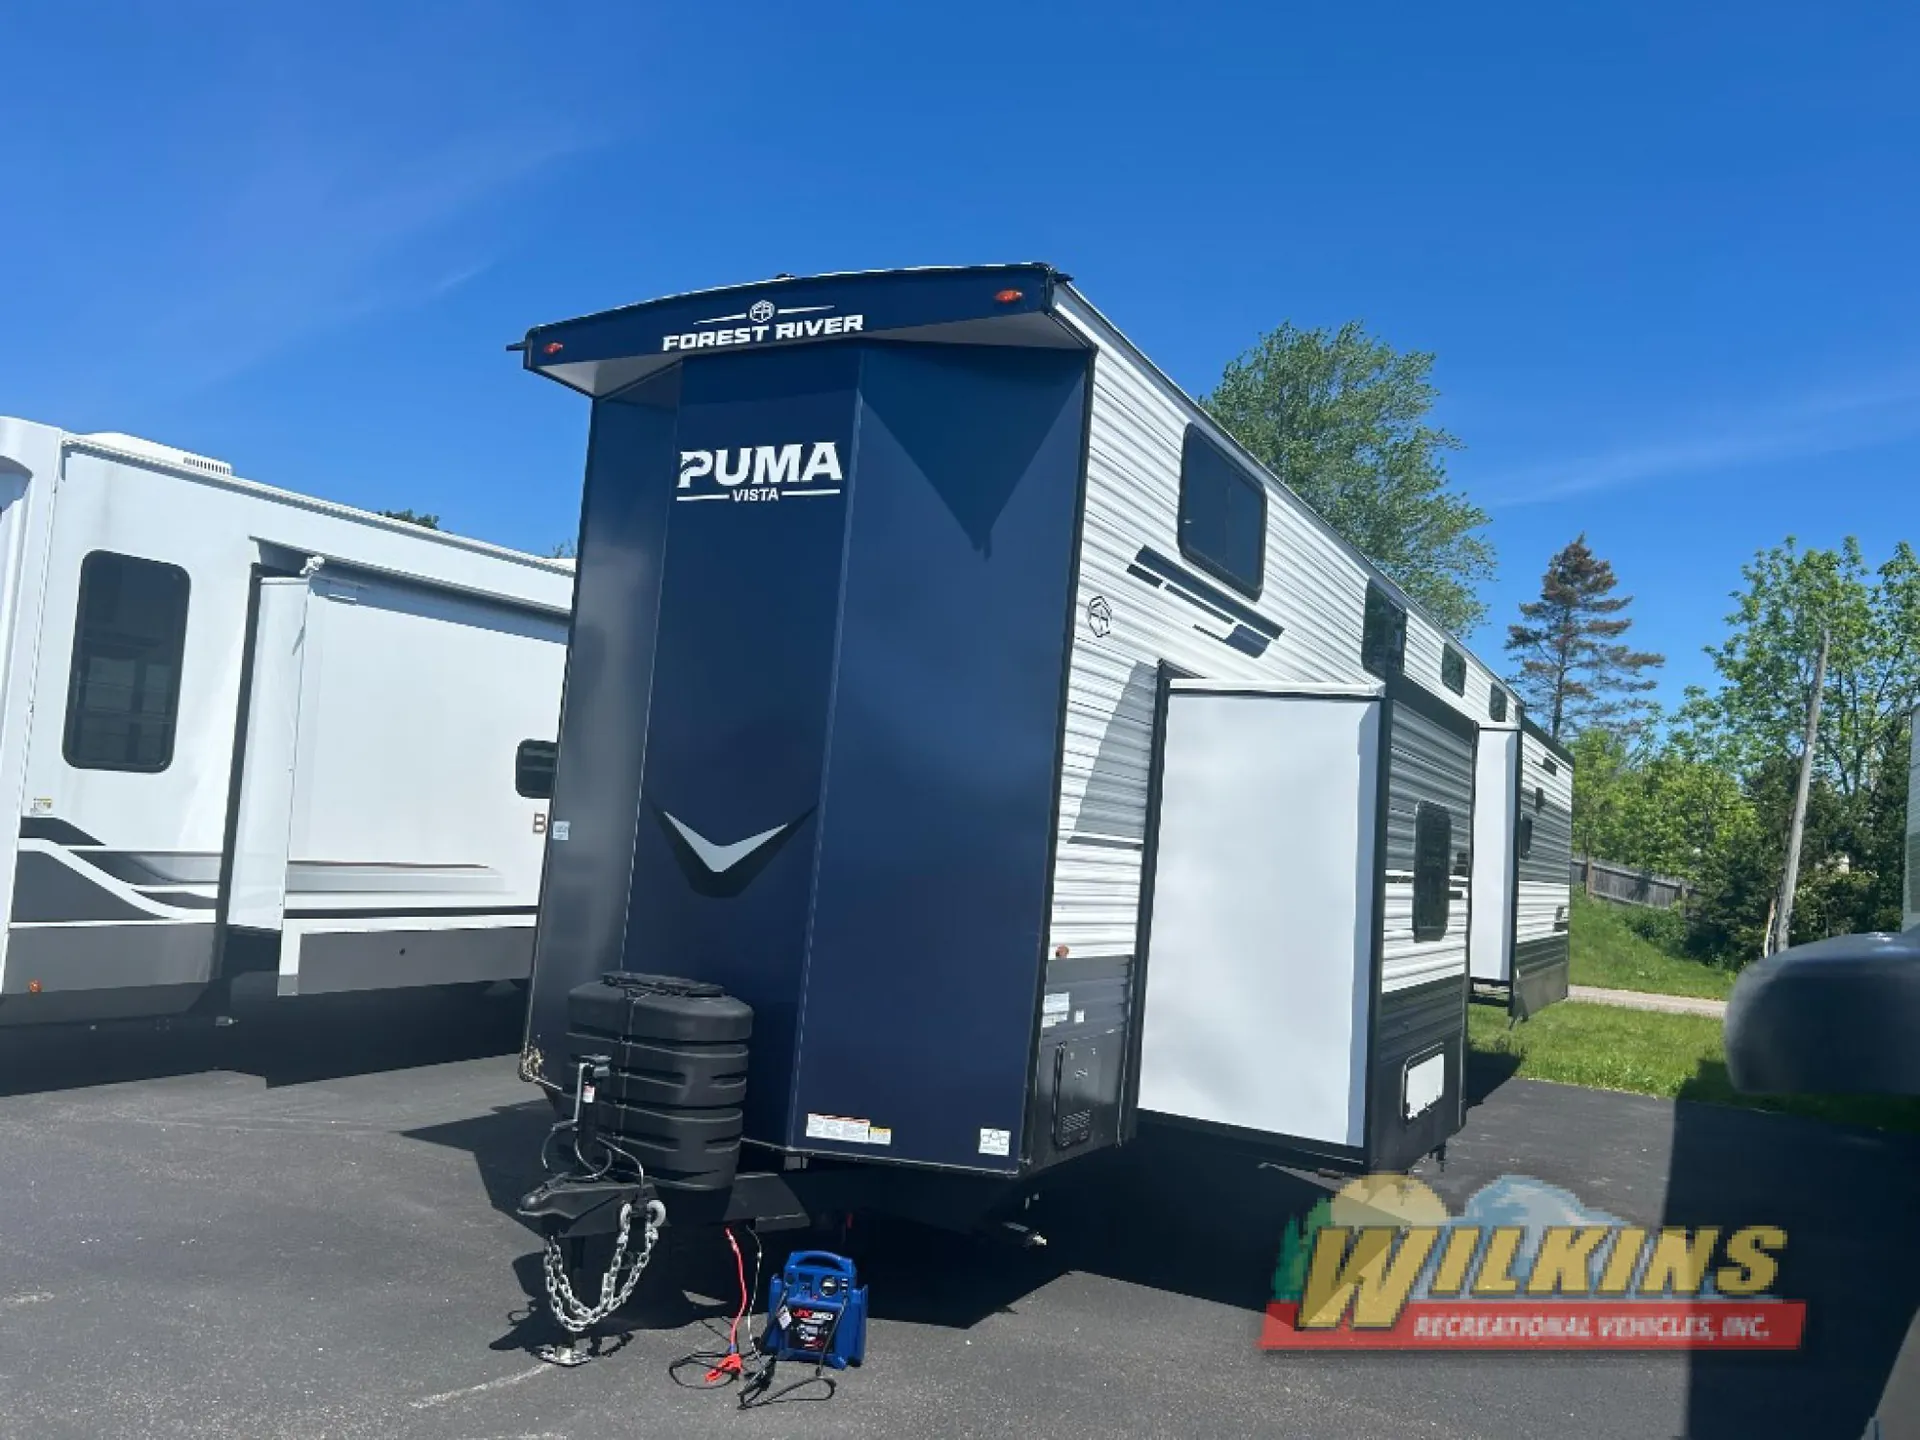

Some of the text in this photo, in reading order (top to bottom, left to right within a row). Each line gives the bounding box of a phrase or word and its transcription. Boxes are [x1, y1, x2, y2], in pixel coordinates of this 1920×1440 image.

[662, 314, 864, 352] FOREST RIVER
[677, 441, 843, 488] PUMA
[732, 487, 779, 503] VISTA
